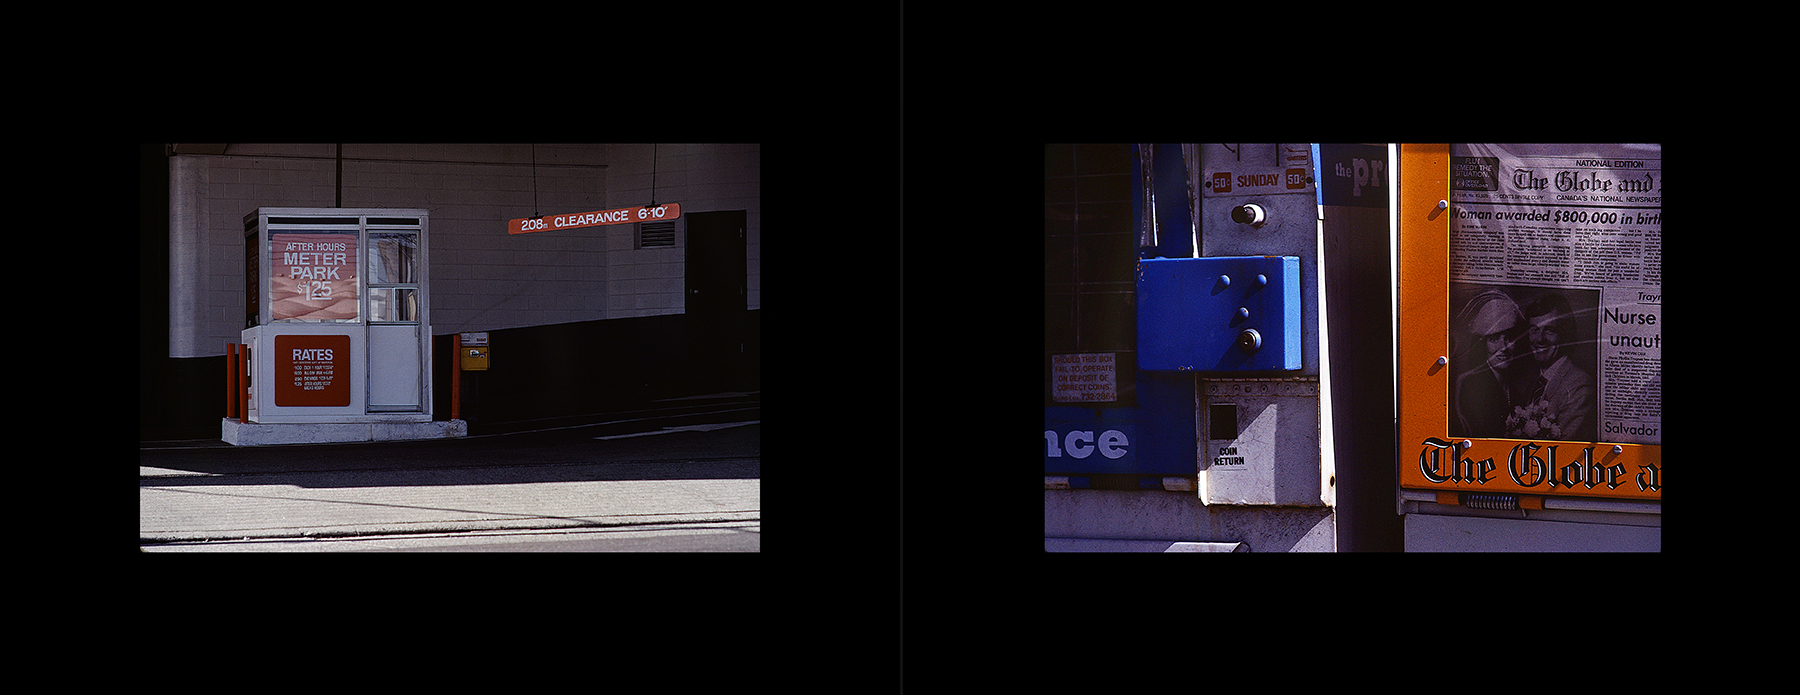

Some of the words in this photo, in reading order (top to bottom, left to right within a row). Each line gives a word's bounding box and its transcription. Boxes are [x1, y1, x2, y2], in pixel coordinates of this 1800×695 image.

[1479, 164, 1492, 172] THE
[1576, 159, 1612, 168] NATIONAL
[1614, 160, 1644, 168] EDITION
[1237, 174, 1279, 188] SUNDAY
[1335, 162, 1352, 178] the
[1352, 158, 1388, 197] pr
[1513, 168, 1549, 191] The
[1555, 170, 1613, 192] Globe
[1618, 172, 1654, 193] and
[554, 210, 629, 228] CLEARANCE
[1451, 207, 1492, 220] Woman
[1495, 209, 1551, 221] awarded
[1554, 209, 1617, 225] $800,000
[1620, 213, 1633, 225] in
[285, 242, 314, 251] AFTER
[316, 242, 346, 251] HOURS
[284, 252, 347, 266] METER
[290, 266, 340, 280] PARK
[1604, 307, 1656, 325] Nurse
[1610, 334, 1661, 348] unaut
[292, 349, 333, 361] RATES
[1054, 356, 1080, 364] SHOULD
[1081, 355, 1097, 363] THIS
[1099, 355, 1113, 363] BOX
[1069, 374, 1098, 382] DEPOSIT
[1604, 421, 1658, 436] Salvador
[1219, 447, 1237, 456] COIN
[1214, 456, 1245, 466] RETURN
[1419, 437, 1497, 485] The
[1507, 442, 1627, 490] Globe
